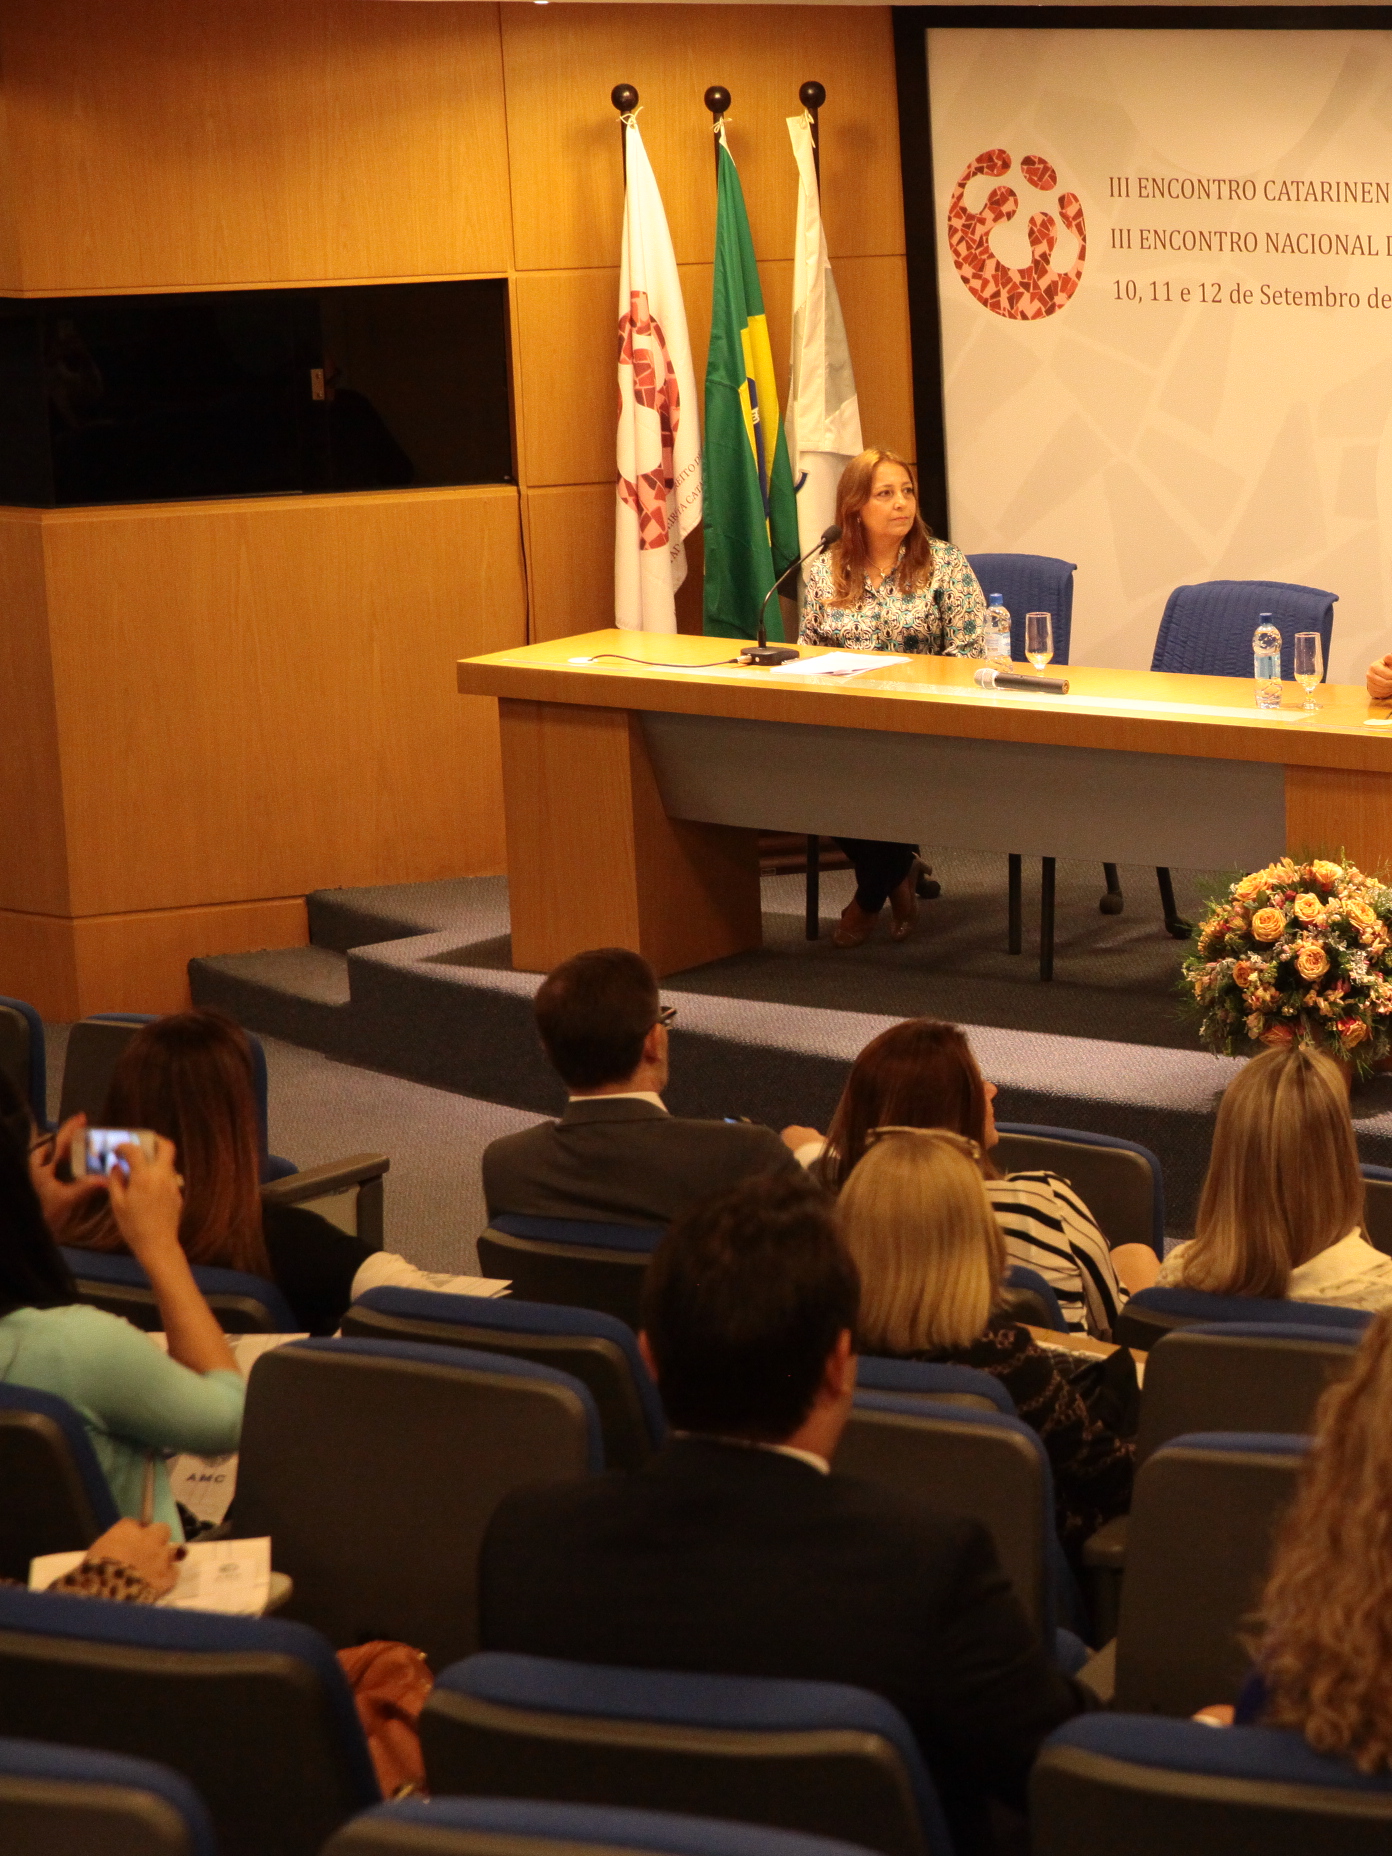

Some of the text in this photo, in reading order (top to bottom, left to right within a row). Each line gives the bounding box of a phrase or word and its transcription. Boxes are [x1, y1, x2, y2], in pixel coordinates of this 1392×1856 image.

[1109, 177, 1130, 197] III
[1138, 177, 1256, 200] ENCONTRO
[1111, 229, 1131, 249] III
[1139, 229, 1257, 252] ENCONTRO
[1266, 233, 1378, 255] NACIONAL
[1114, 280, 1142, 303] 10,
[1150, 281, 1172, 301] 11
[1181, 288, 1190, 302] e
[1199, 283, 1222, 303] 12
[1230, 283, 1253, 304] de
[1261, 284, 1360, 307] Setembro
[1368, 287, 1391, 309] de
[186, 1472, 226, 1484] AMC
